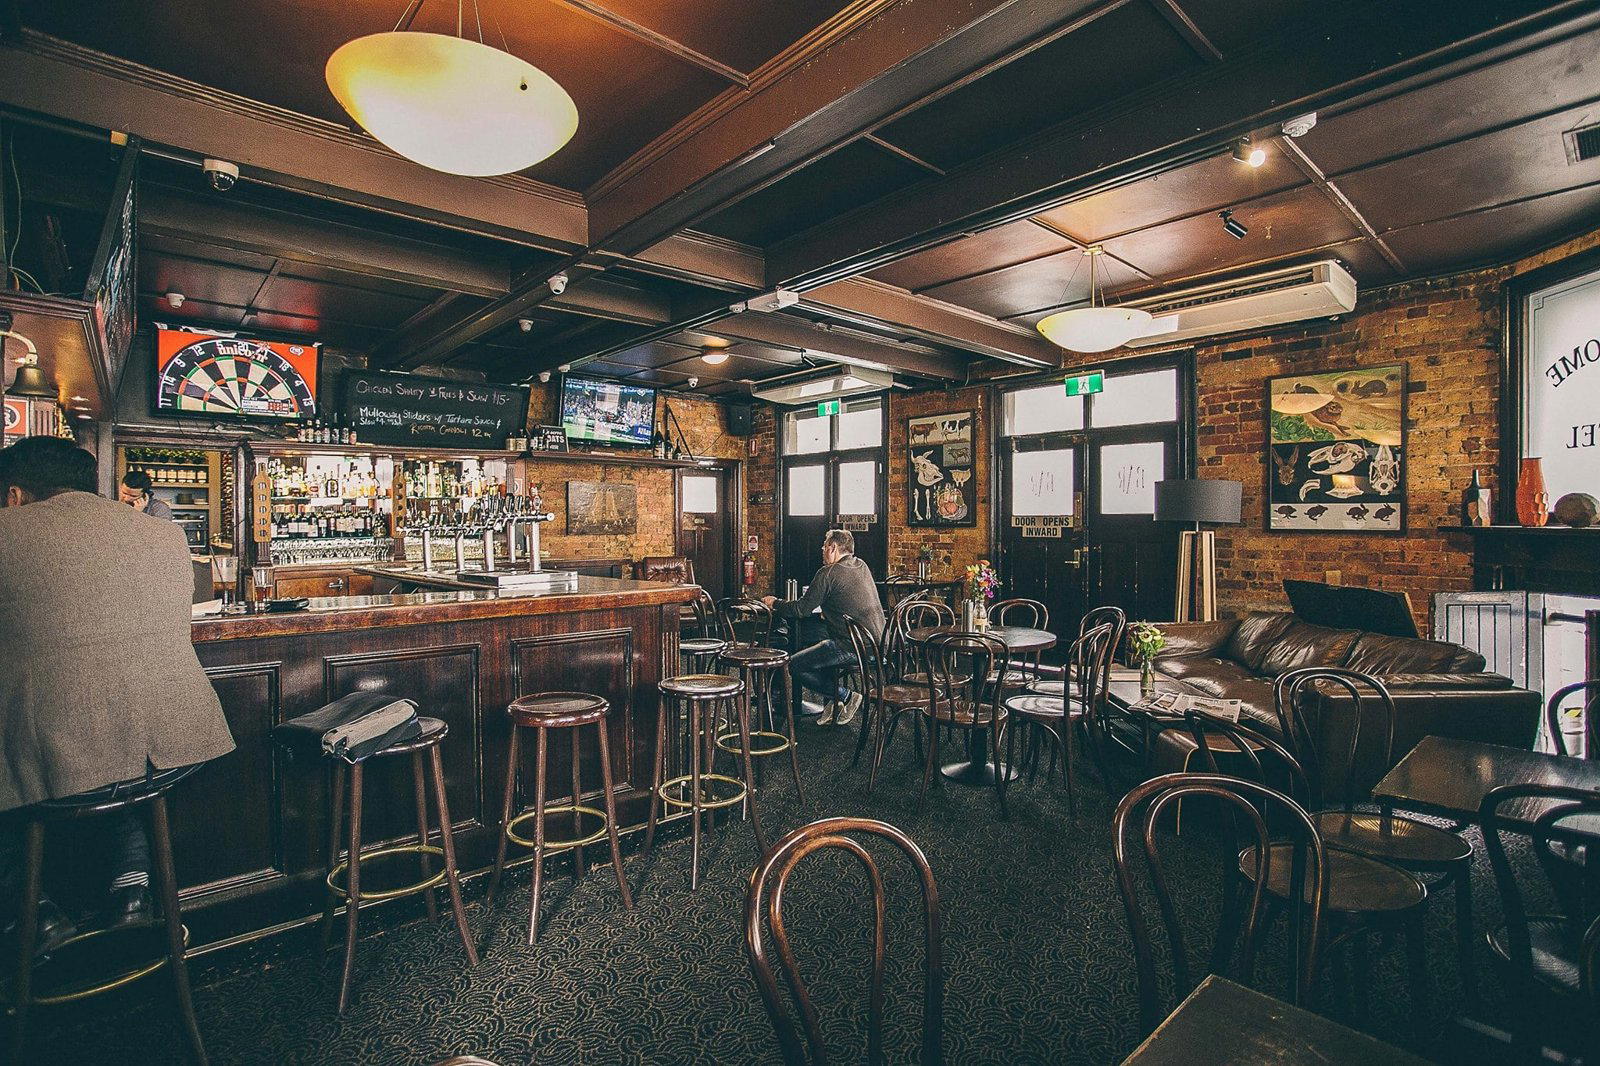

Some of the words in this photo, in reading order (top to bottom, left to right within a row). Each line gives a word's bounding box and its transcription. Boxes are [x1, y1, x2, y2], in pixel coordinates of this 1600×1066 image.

[191, 344, 206, 357] 12
[173, 358, 186, 368] 9
[278, 359, 290, 371] 18
[162, 375, 176, 387] 14
[301, 396, 314, 407] 13
[1015, 517, 1036, 526] DOOR
[1042, 516, 1070, 526] OPENS
[1025, 527, 1058, 537] INWARD
